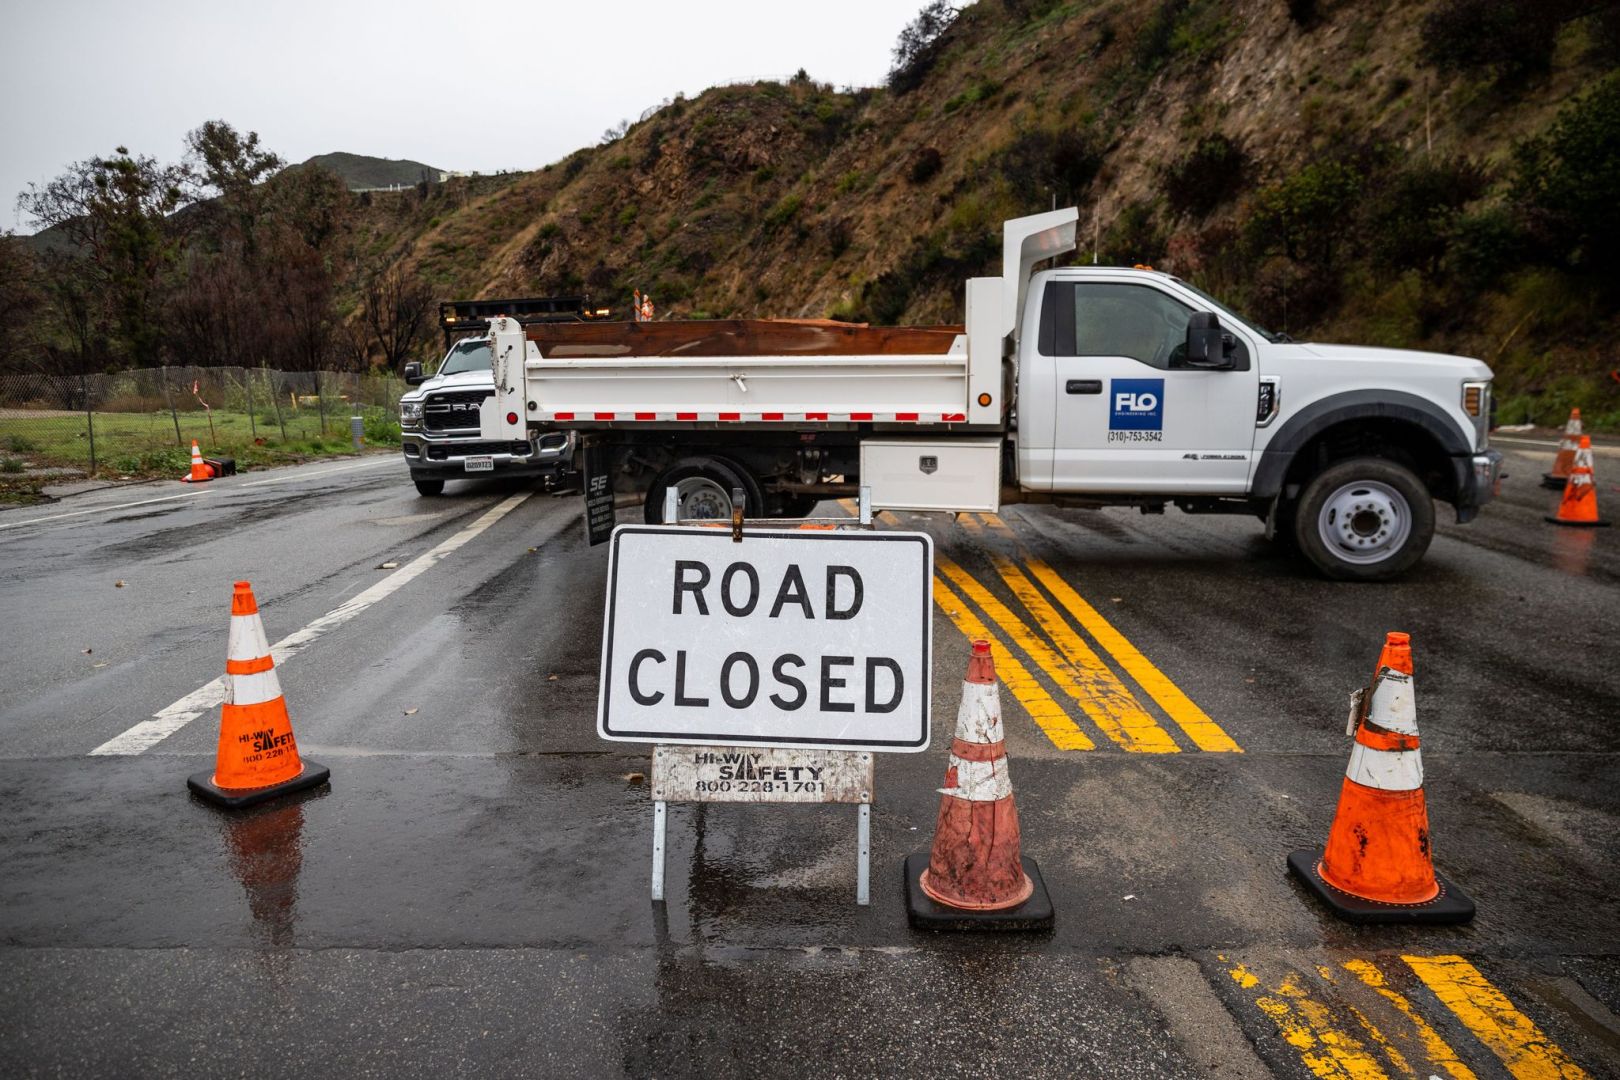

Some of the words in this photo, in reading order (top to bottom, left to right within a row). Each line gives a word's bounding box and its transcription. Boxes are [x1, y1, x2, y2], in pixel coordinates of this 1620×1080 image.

[452, 403, 481, 411] RA
[1115, 392, 1158, 411] FLO
[1107, 431, 1163, 443] (310)-753-3542
[589, 475, 608, 492] SE
[671, 560, 864, 620] ROAD
[628, 648, 904, 713] CLOSED
[695, 753, 761, 765] HI-WAY
[719, 762, 825, 781] SAFETY
